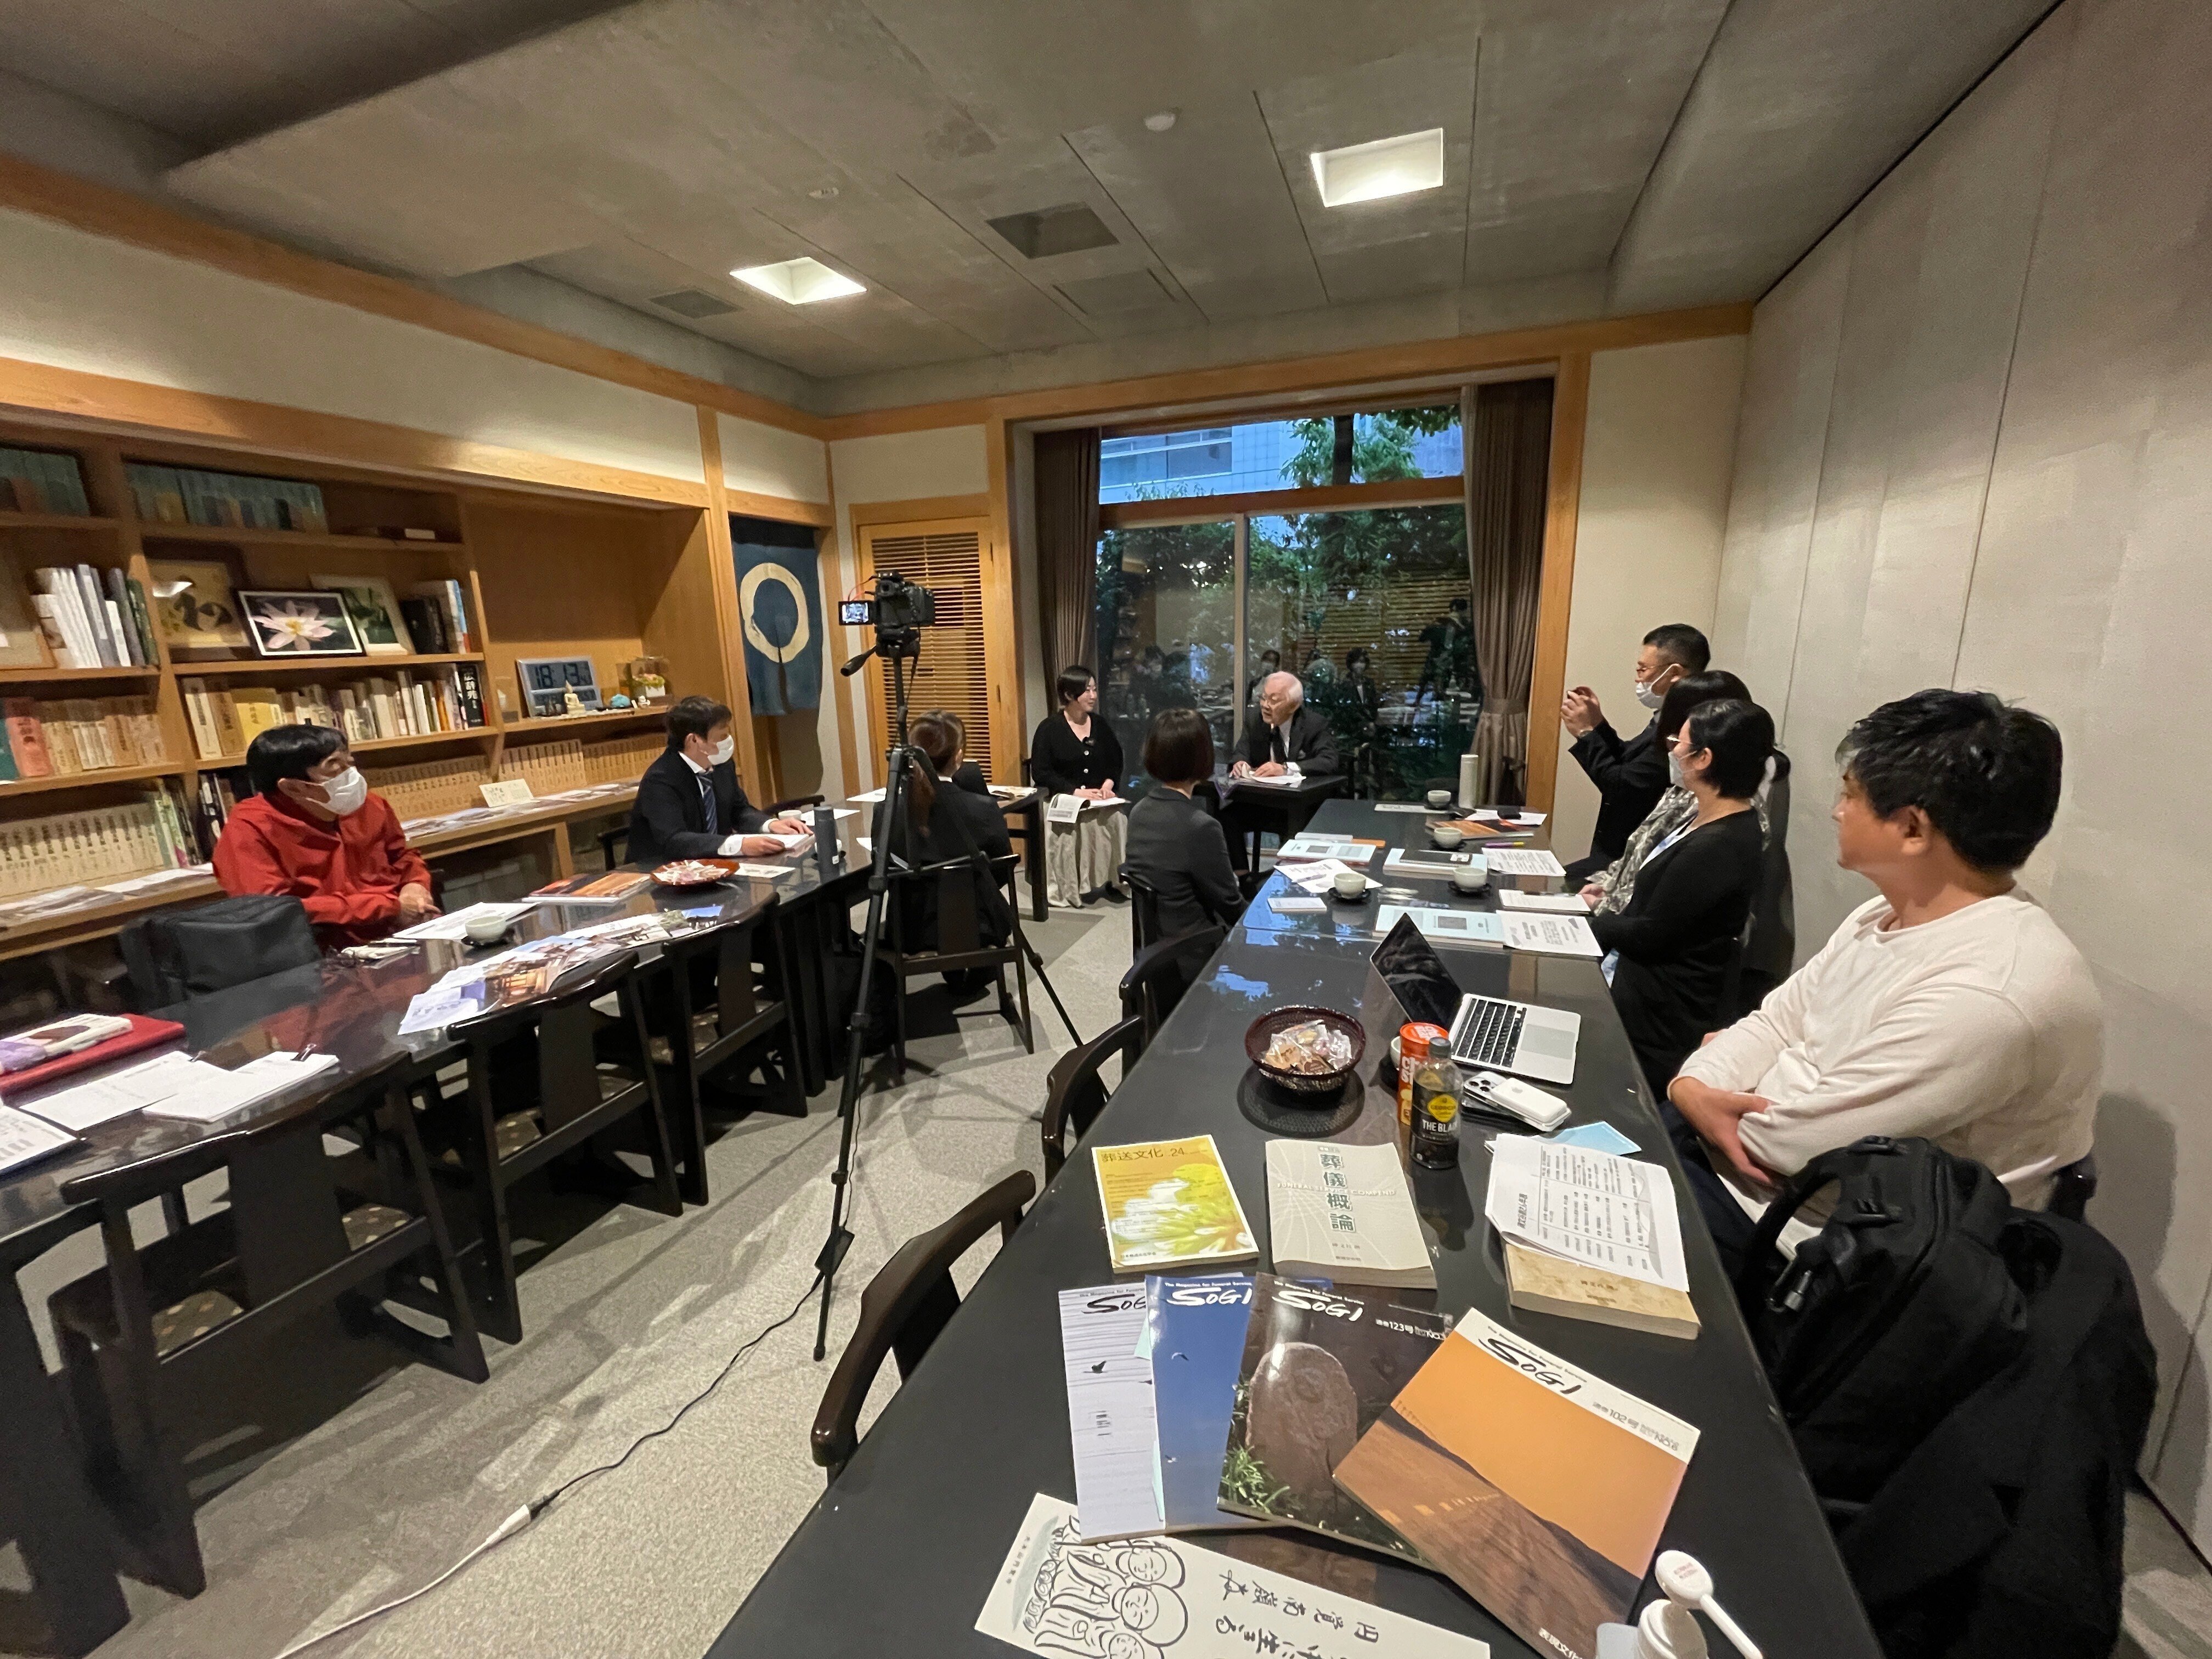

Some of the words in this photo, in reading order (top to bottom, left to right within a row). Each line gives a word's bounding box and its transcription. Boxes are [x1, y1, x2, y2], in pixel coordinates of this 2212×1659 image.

[1422, 1120, 1436, 1131] THE
[1319, 1154, 1355, 1231] 葬儀概論
[1166, 1287, 1253, 1306] SOGI
[1272, 1291, 1363, 1322] SOGI
[1479, 1339, 1582, 1394] SOGI
